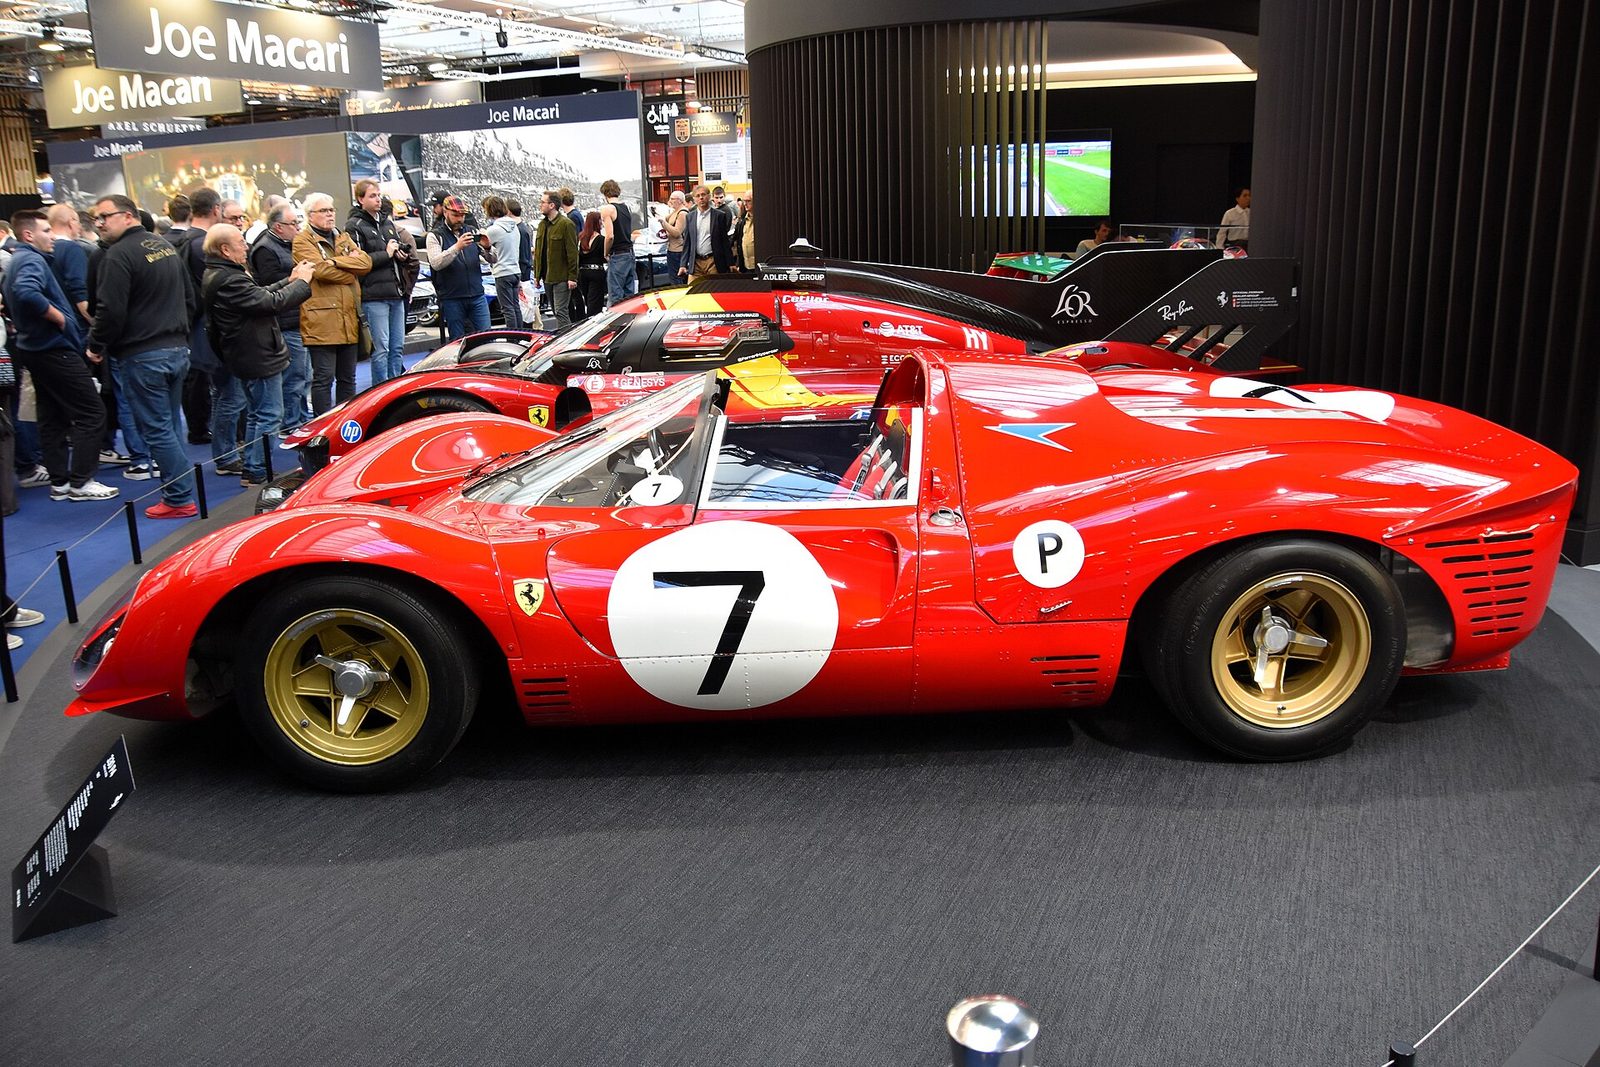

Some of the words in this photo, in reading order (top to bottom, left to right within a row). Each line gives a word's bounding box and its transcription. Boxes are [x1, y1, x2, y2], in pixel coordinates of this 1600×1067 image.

[144, 7, 217, 61] Joe
[226, 18, 350, 74] Macari
[71, 79, 115, 115] Joe
[487, 108, 510, 124] Joe
[512, 102, 560, 121] Macari
[93, 144, 110, 158] Joe
[109, 140, 144, 157] Macari
[762, 273, 789, 281] ADLER
[798, 273, 826, 281] GROUP
[1157, 300, 1194, 321] Ray-Ban
[897, 324, 923, 335] AT&T
[620, 377, 666, 387] GENESYS
[652, 483, 662, 498] 7
[1037, 532, 1063, 574] P
[652, 570, 766, 696] 7
